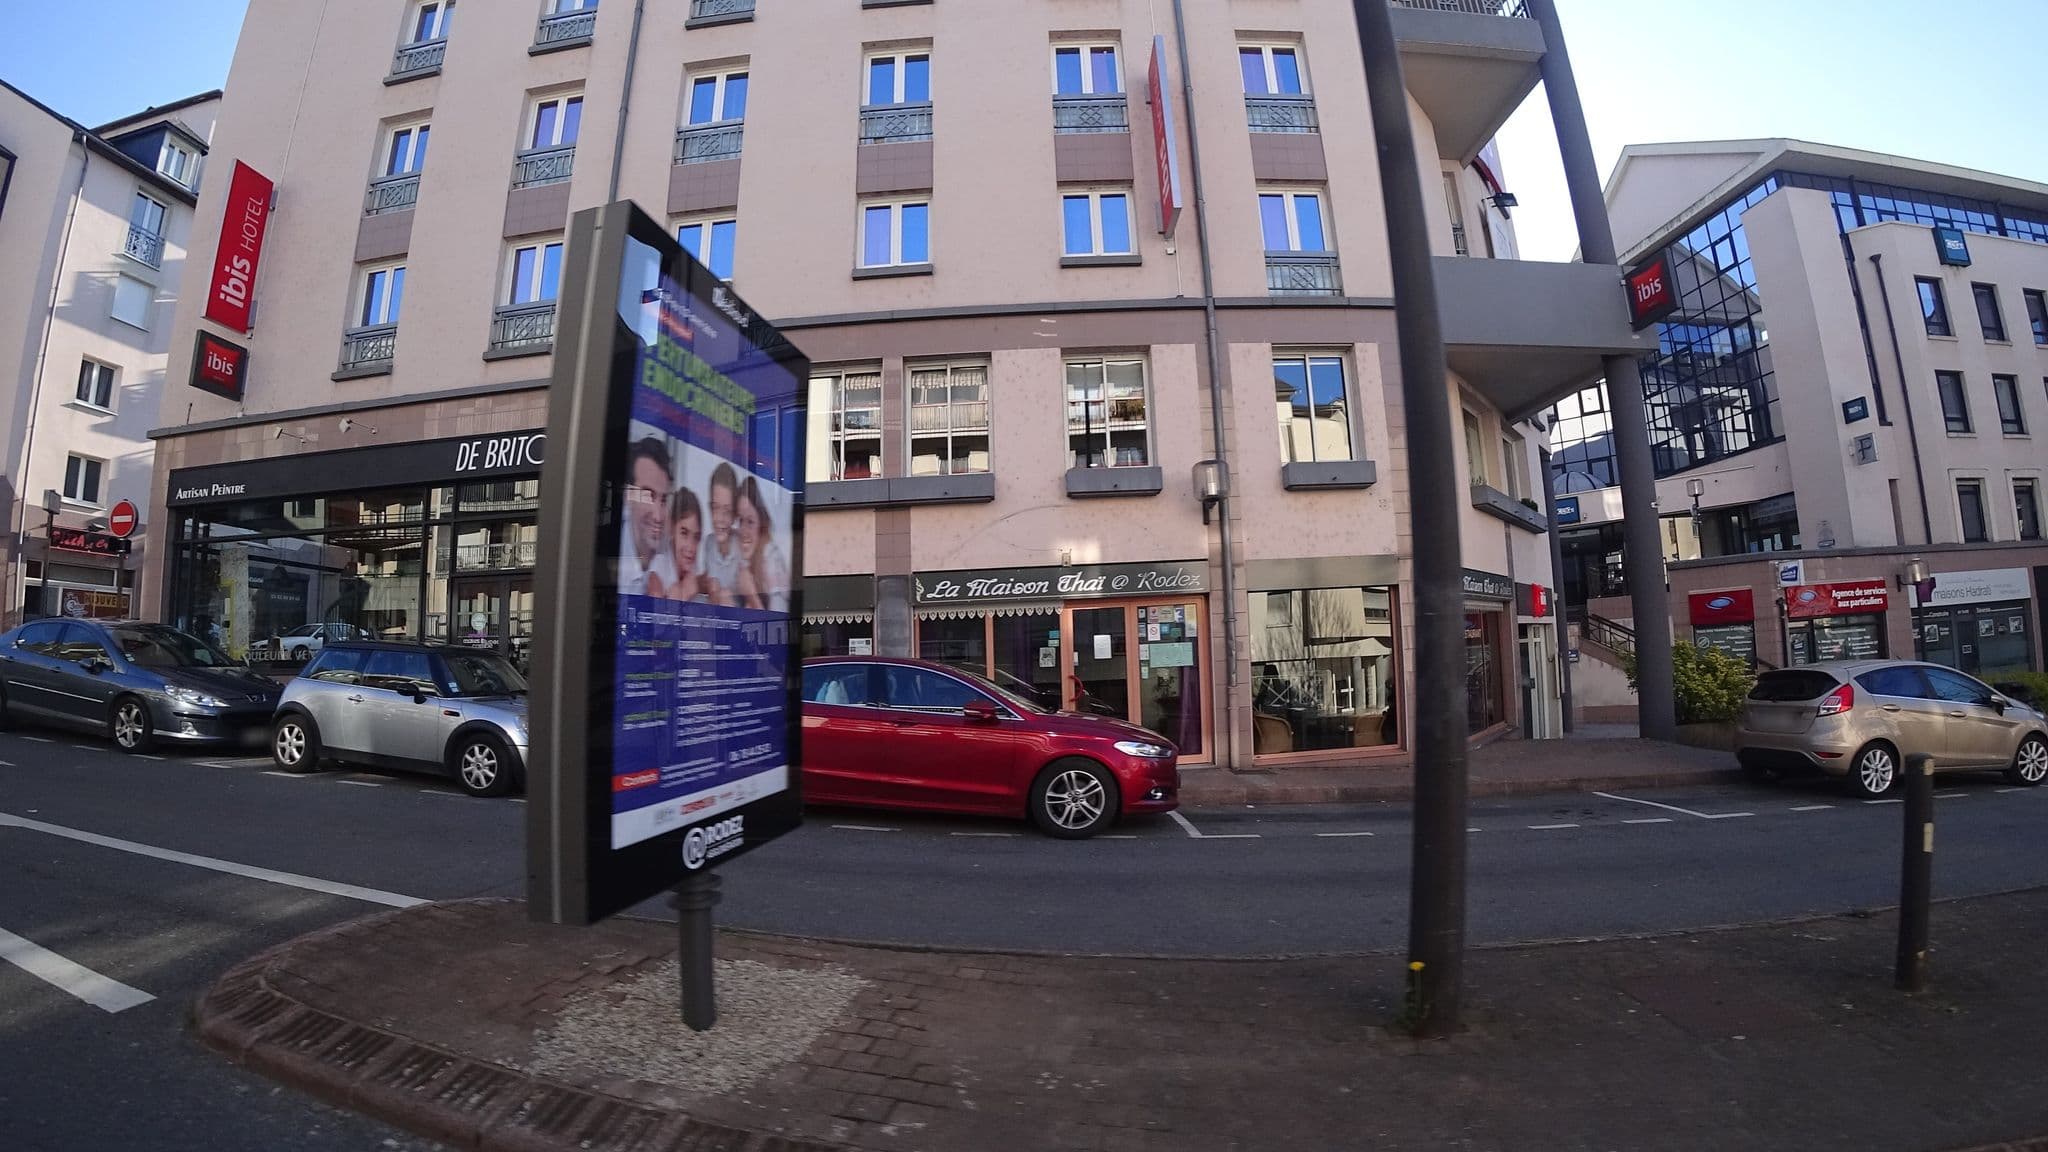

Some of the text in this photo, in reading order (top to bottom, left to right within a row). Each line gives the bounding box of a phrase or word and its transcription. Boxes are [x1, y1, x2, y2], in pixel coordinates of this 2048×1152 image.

[219, 196, 264, 308] ibis HOTEL
[1637, 278, 1662, 302] ibis
[207, 352, 234, 376] ibis
[455, 441, 482, 472] DE
[926, 568, 1202, 599] La Maison Thaï @ Rodez
[1831, 586, 1888, 600] Agence de services
[1934, 589, 1965, 600] maisons
[1837, 596, 1884, 609] aux particuliers
